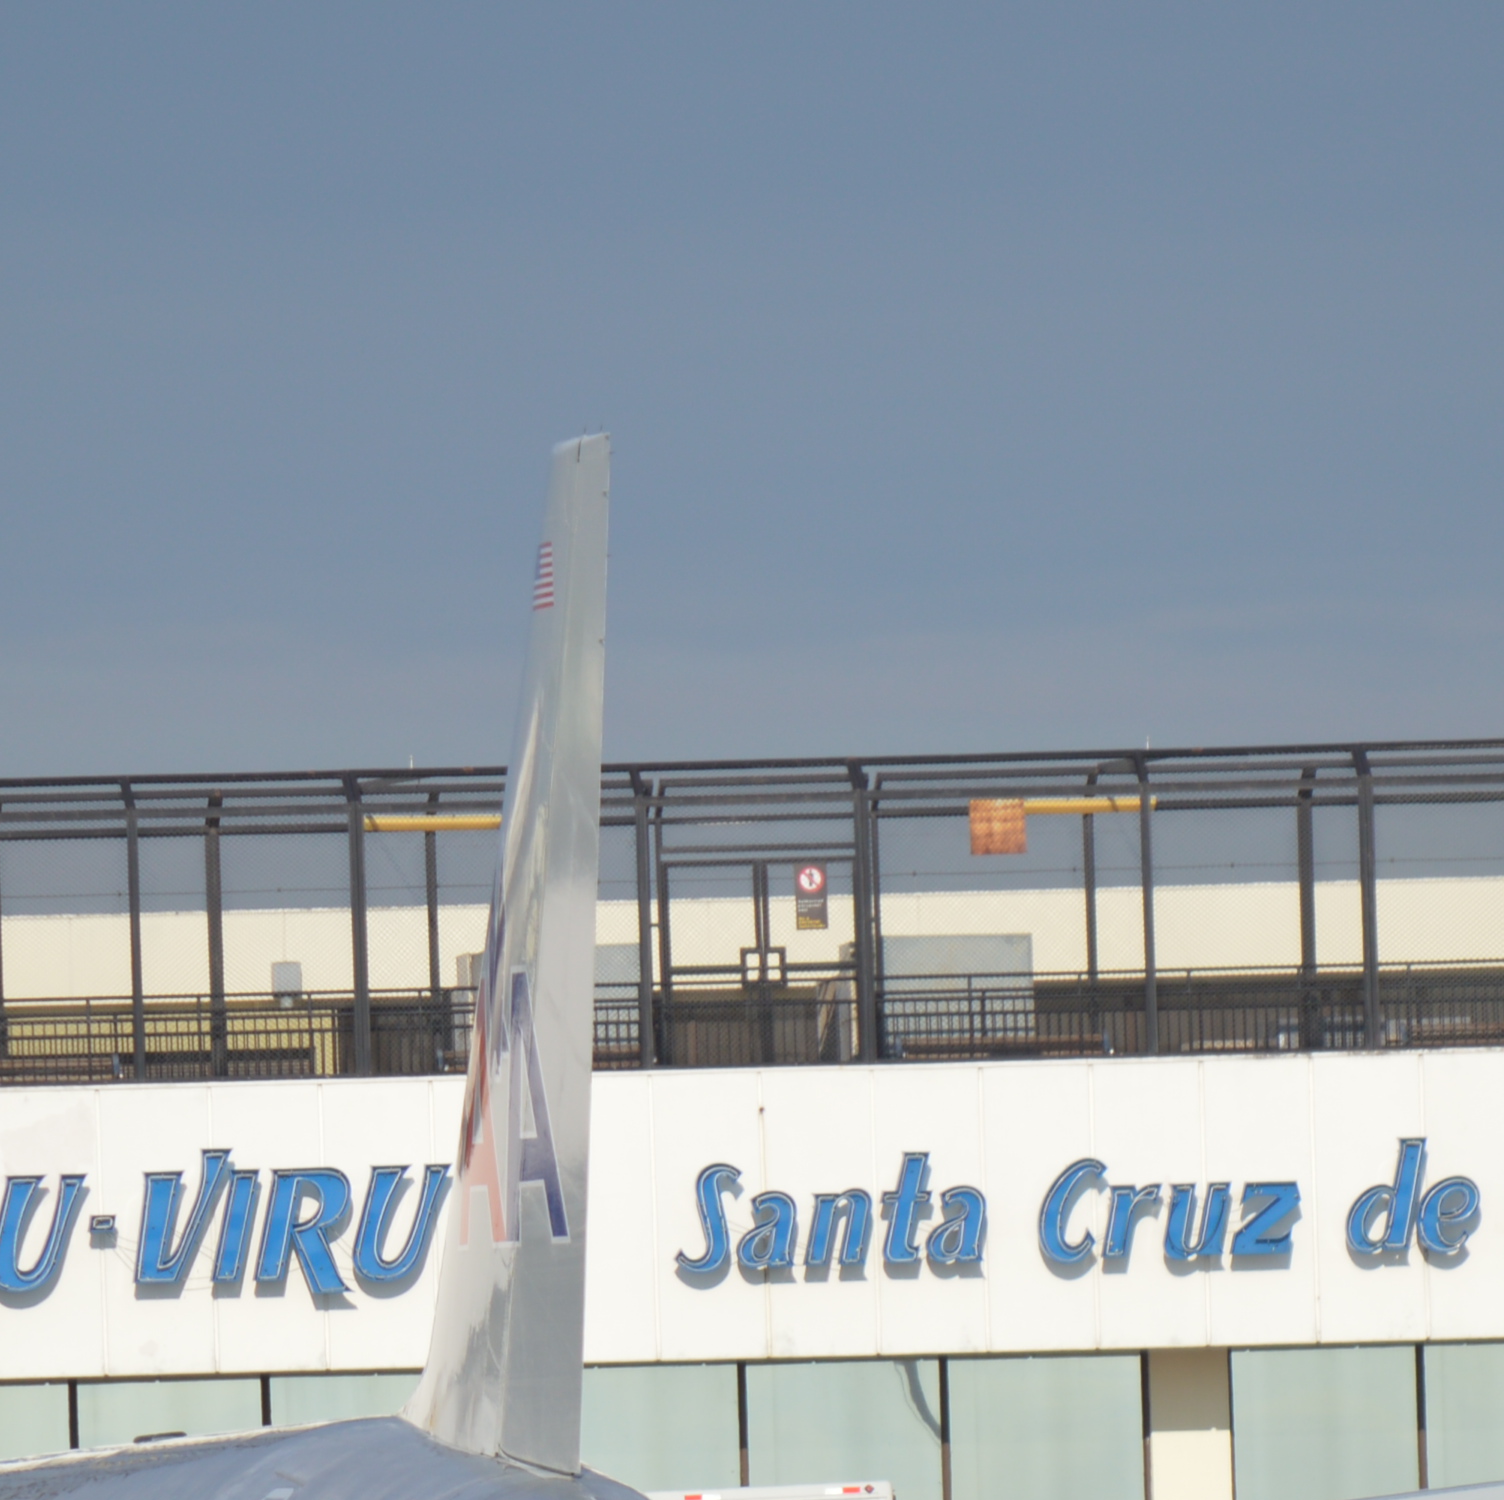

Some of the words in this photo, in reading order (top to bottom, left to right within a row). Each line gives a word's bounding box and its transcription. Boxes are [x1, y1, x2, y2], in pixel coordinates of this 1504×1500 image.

[674, 1151, 988, 1272] Santa
[1037, 1157, 1302, 1264] Cruz
[1345, 1136, 1481, 1255] de
